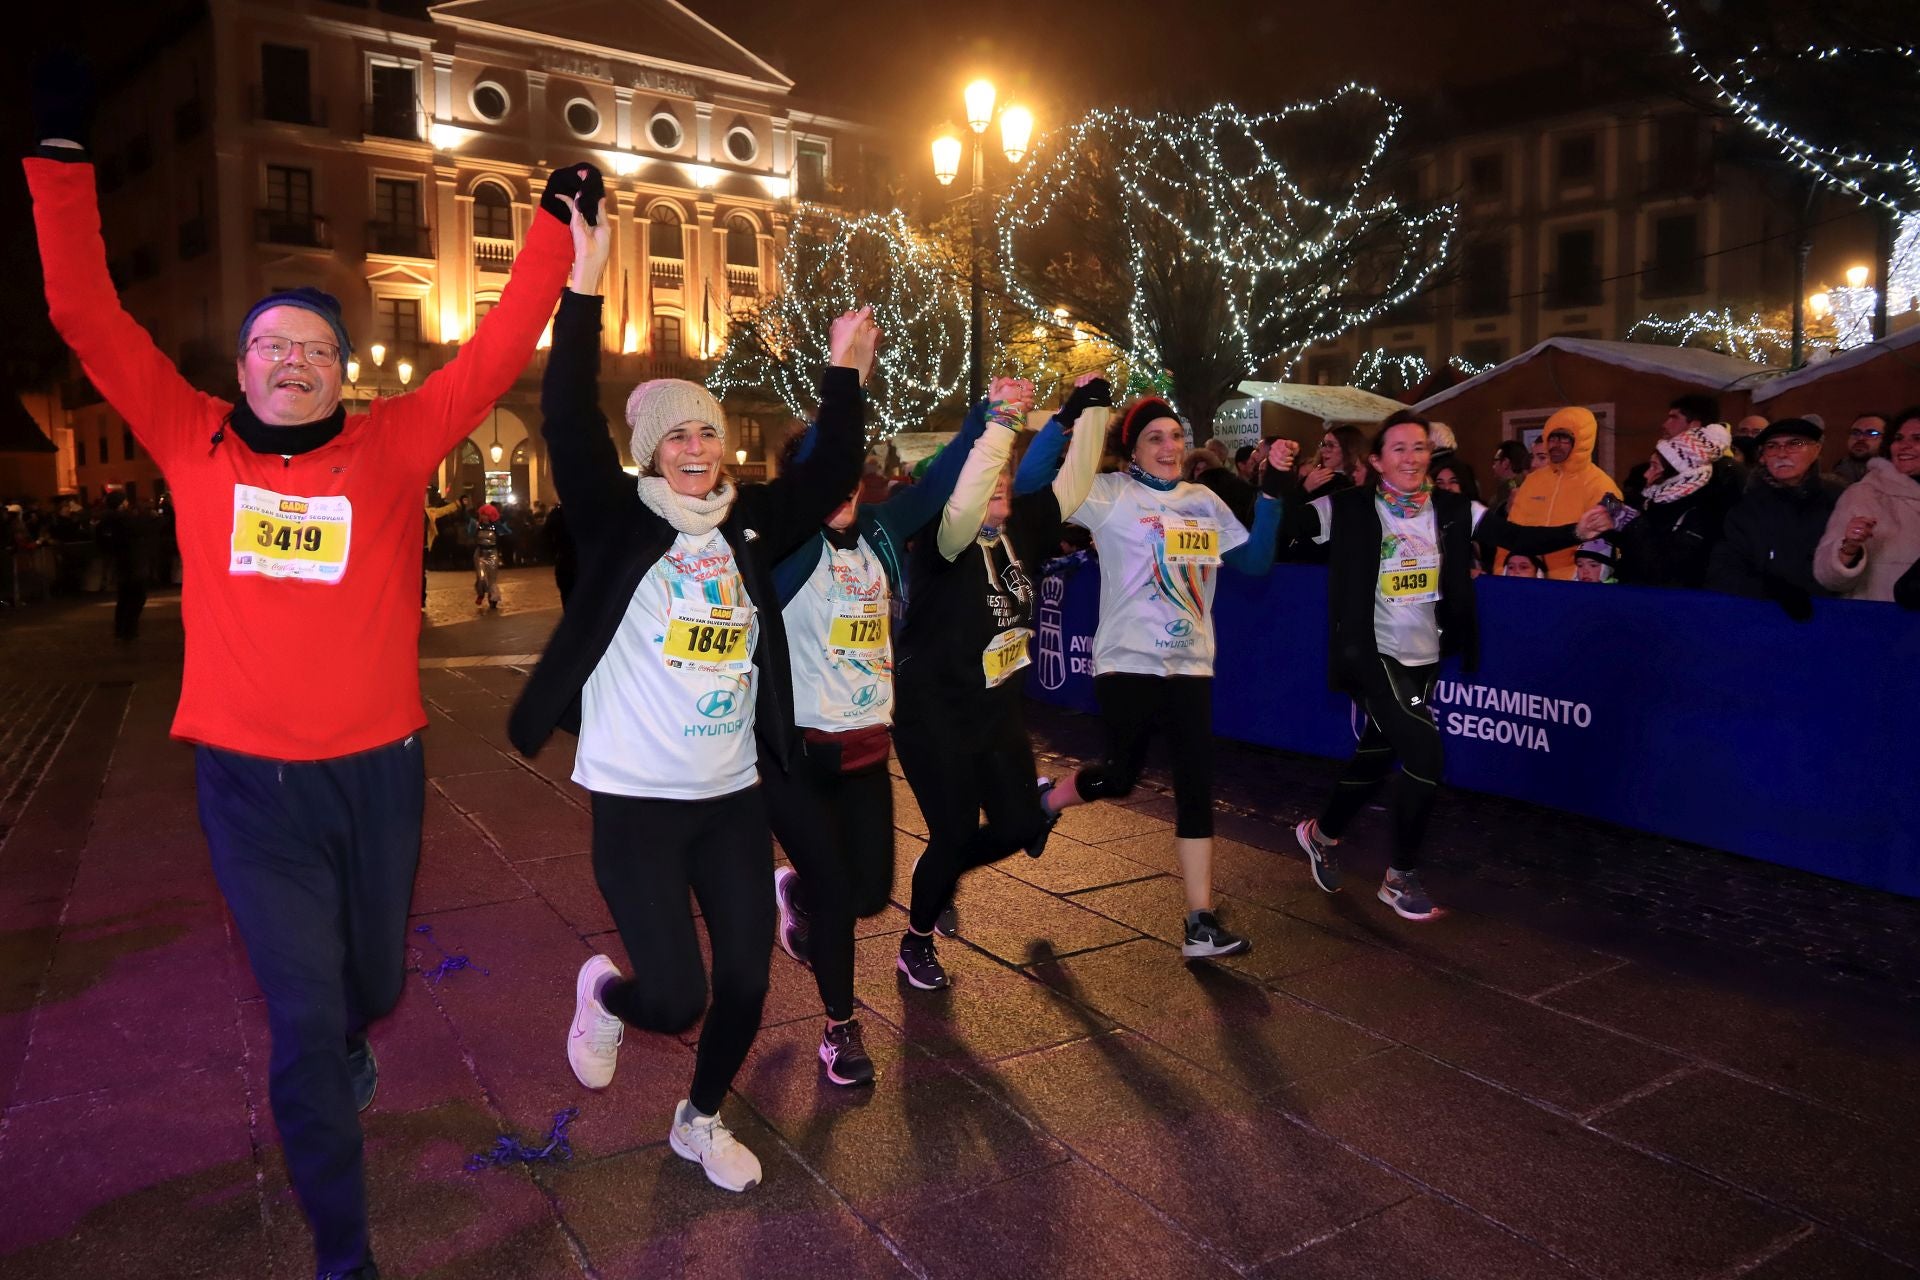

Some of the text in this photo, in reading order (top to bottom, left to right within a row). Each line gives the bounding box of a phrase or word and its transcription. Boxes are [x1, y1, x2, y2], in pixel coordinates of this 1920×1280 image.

[1221, 423, 1259, 435] NAVIDAD
[1225, 437, 1259, 449] VIDEÑOS
[257, 520, 322, 551] 3419
[1178, 531, 1209, 550] 1720
[1391, 573, 1428, 591] 3439
[688, 625, 741, 654] 1845
[850, 619, 882, 642] 1723
[1433, 680, 1592, 728] YUNTAMIENTO
[684, 720, 743, 736] HYUNDA
[1446, 712, 1550, 753] SEGOVIA
